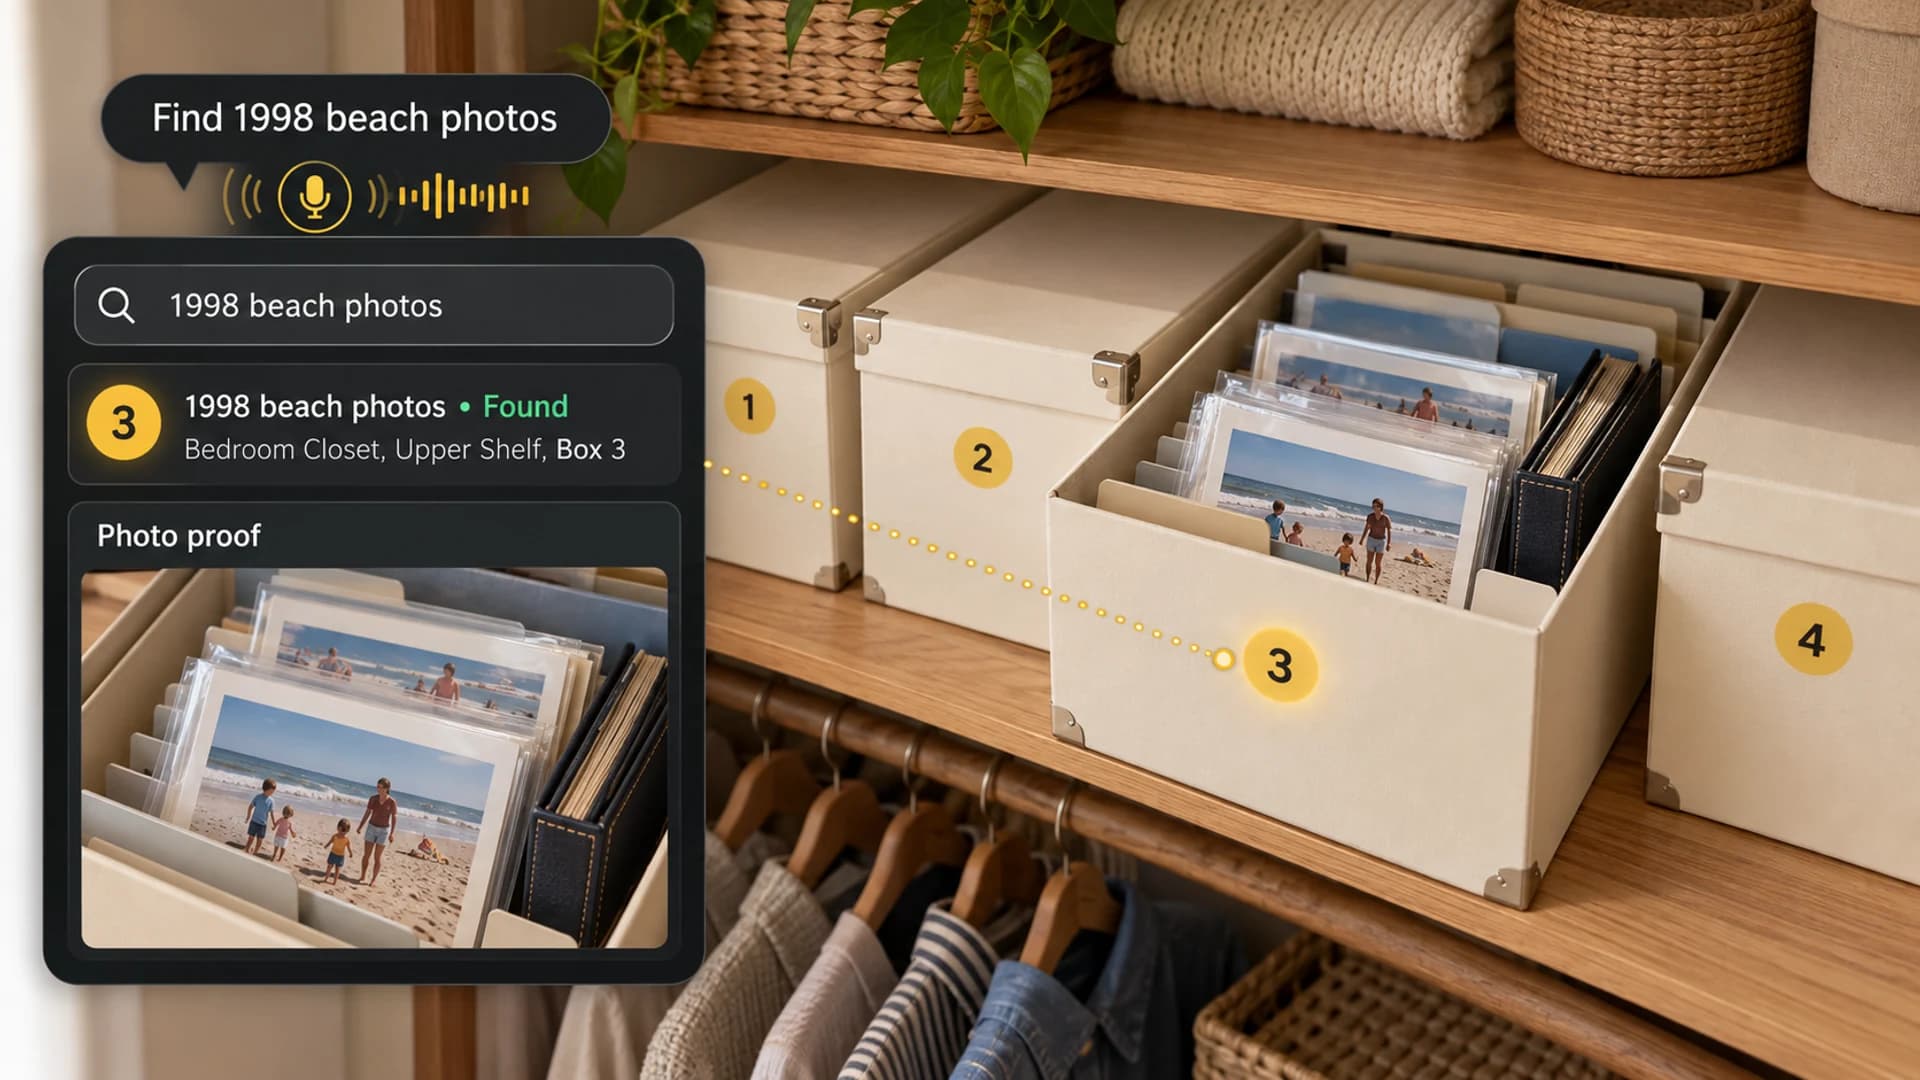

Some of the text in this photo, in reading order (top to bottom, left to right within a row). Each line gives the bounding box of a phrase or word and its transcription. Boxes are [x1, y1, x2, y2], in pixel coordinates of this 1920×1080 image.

[742, 393, 754, 421] 1
[973, 443, 993, 474] 2
[1797, 623, 1826, 658] 4
[1267, 647, 1292, 684] 3
